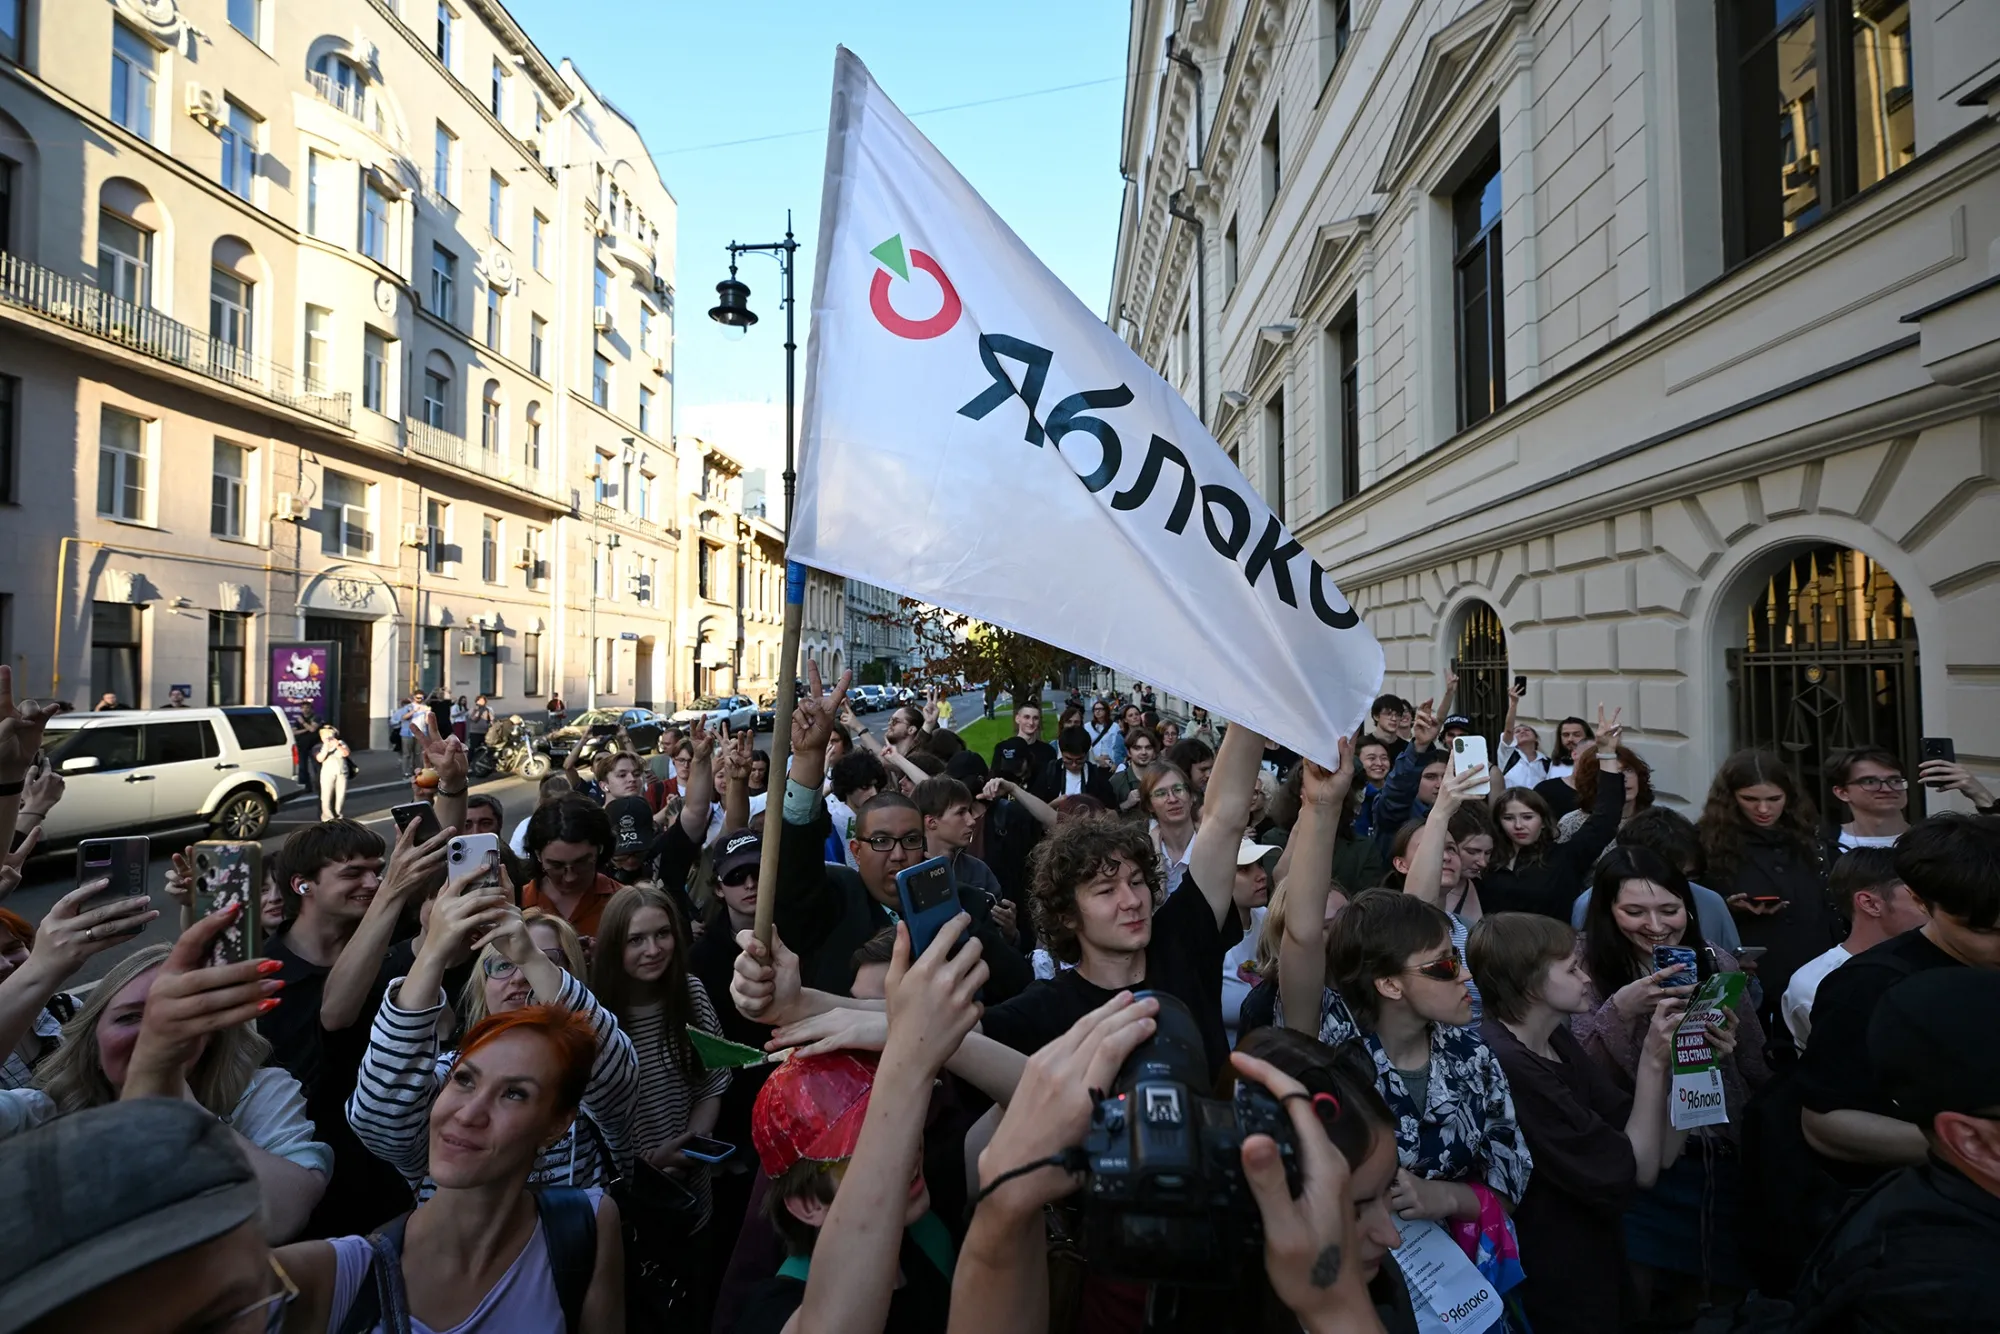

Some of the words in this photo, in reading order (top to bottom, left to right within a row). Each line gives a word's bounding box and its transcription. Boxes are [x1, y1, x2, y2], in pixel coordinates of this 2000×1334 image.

[620, 832, 638, 841] Y-3
[930, 867, 945, 879] POCO
[1676, 1036, 1685, 1048] ЗА
[1685, 1034, 1704, 1047] ЖИЗНЬ
[1677, 1050, 1690, 1063] БЕЗ
[1689, 1047, 1713, 1062] СТРАХА!
[1687, 1089, 1722, 1110] Яблоко
[1448, 1288, 1489, 1323] Яблоко
